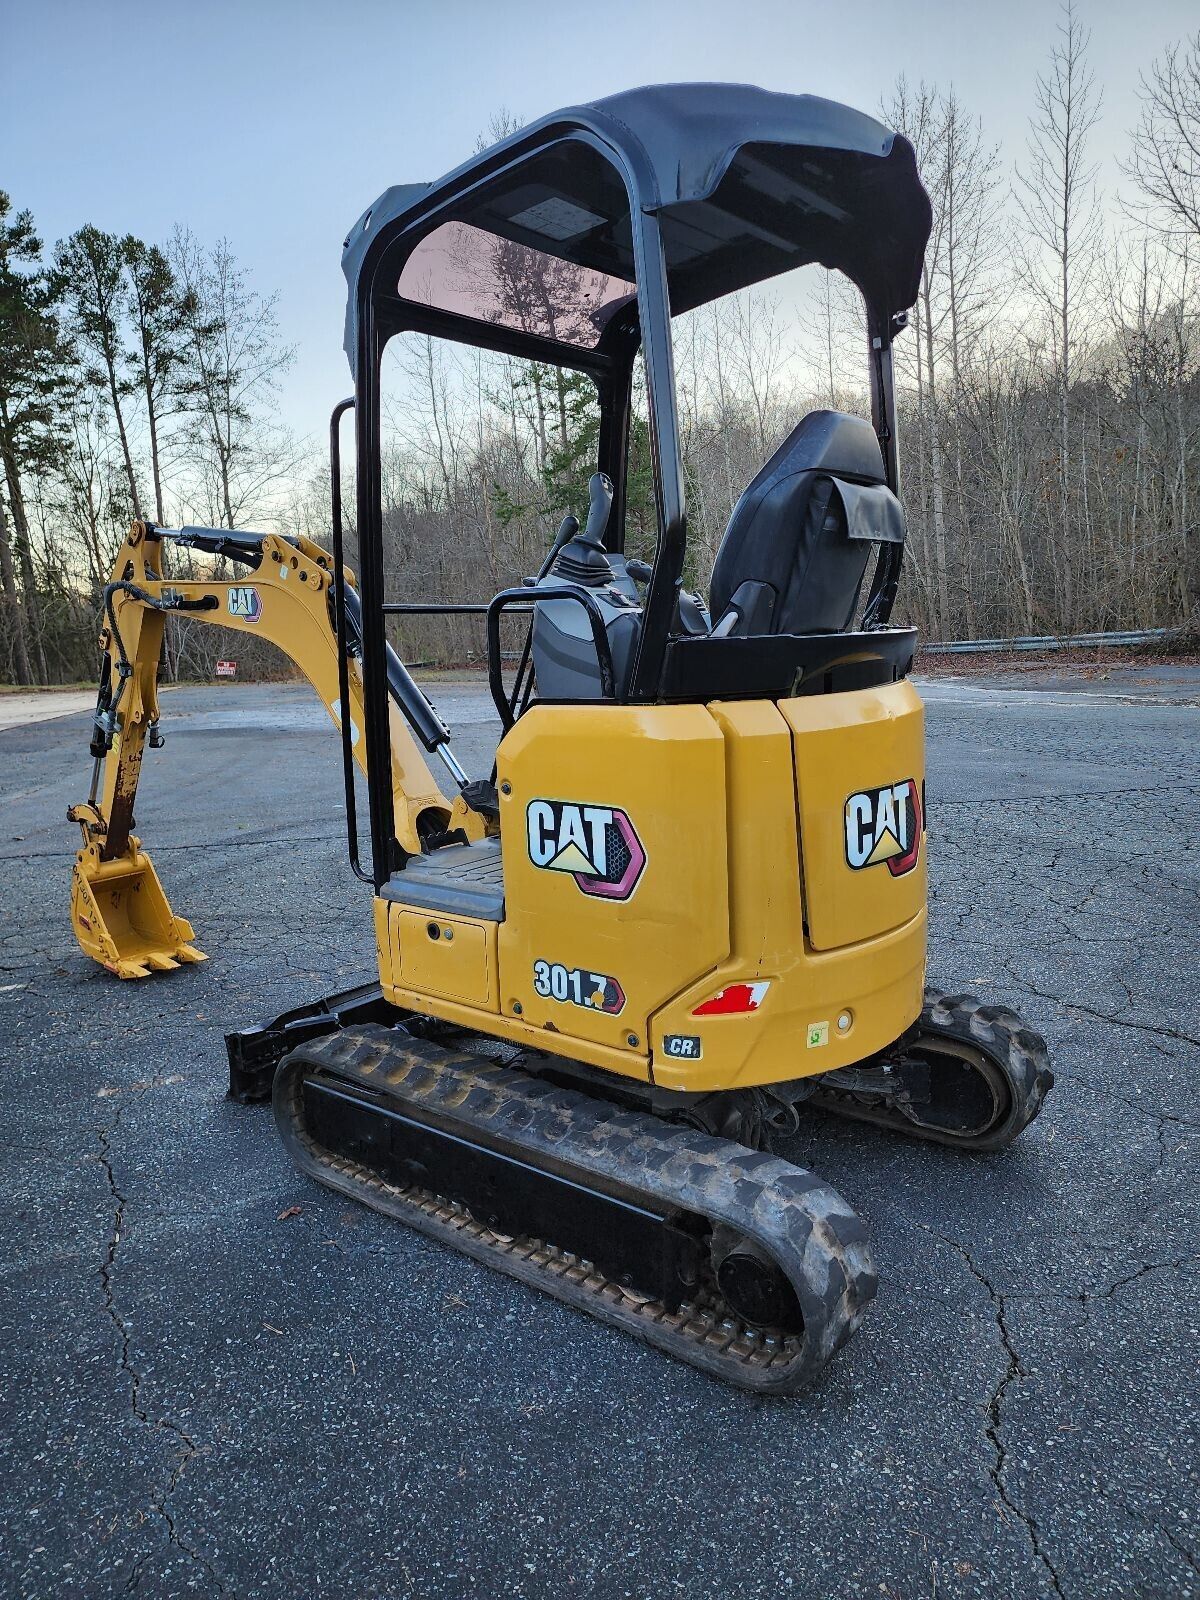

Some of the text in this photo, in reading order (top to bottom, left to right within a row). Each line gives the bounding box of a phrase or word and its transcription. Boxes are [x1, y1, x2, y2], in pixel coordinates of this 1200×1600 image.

[228, 588, 253, 615] CAT
[527, 801, 613, 876] CAT
[846, 782, 910, 867] CAT
[534, 961, 607, 1010] 301.7
[670, 1038, 694, 1055] CR
